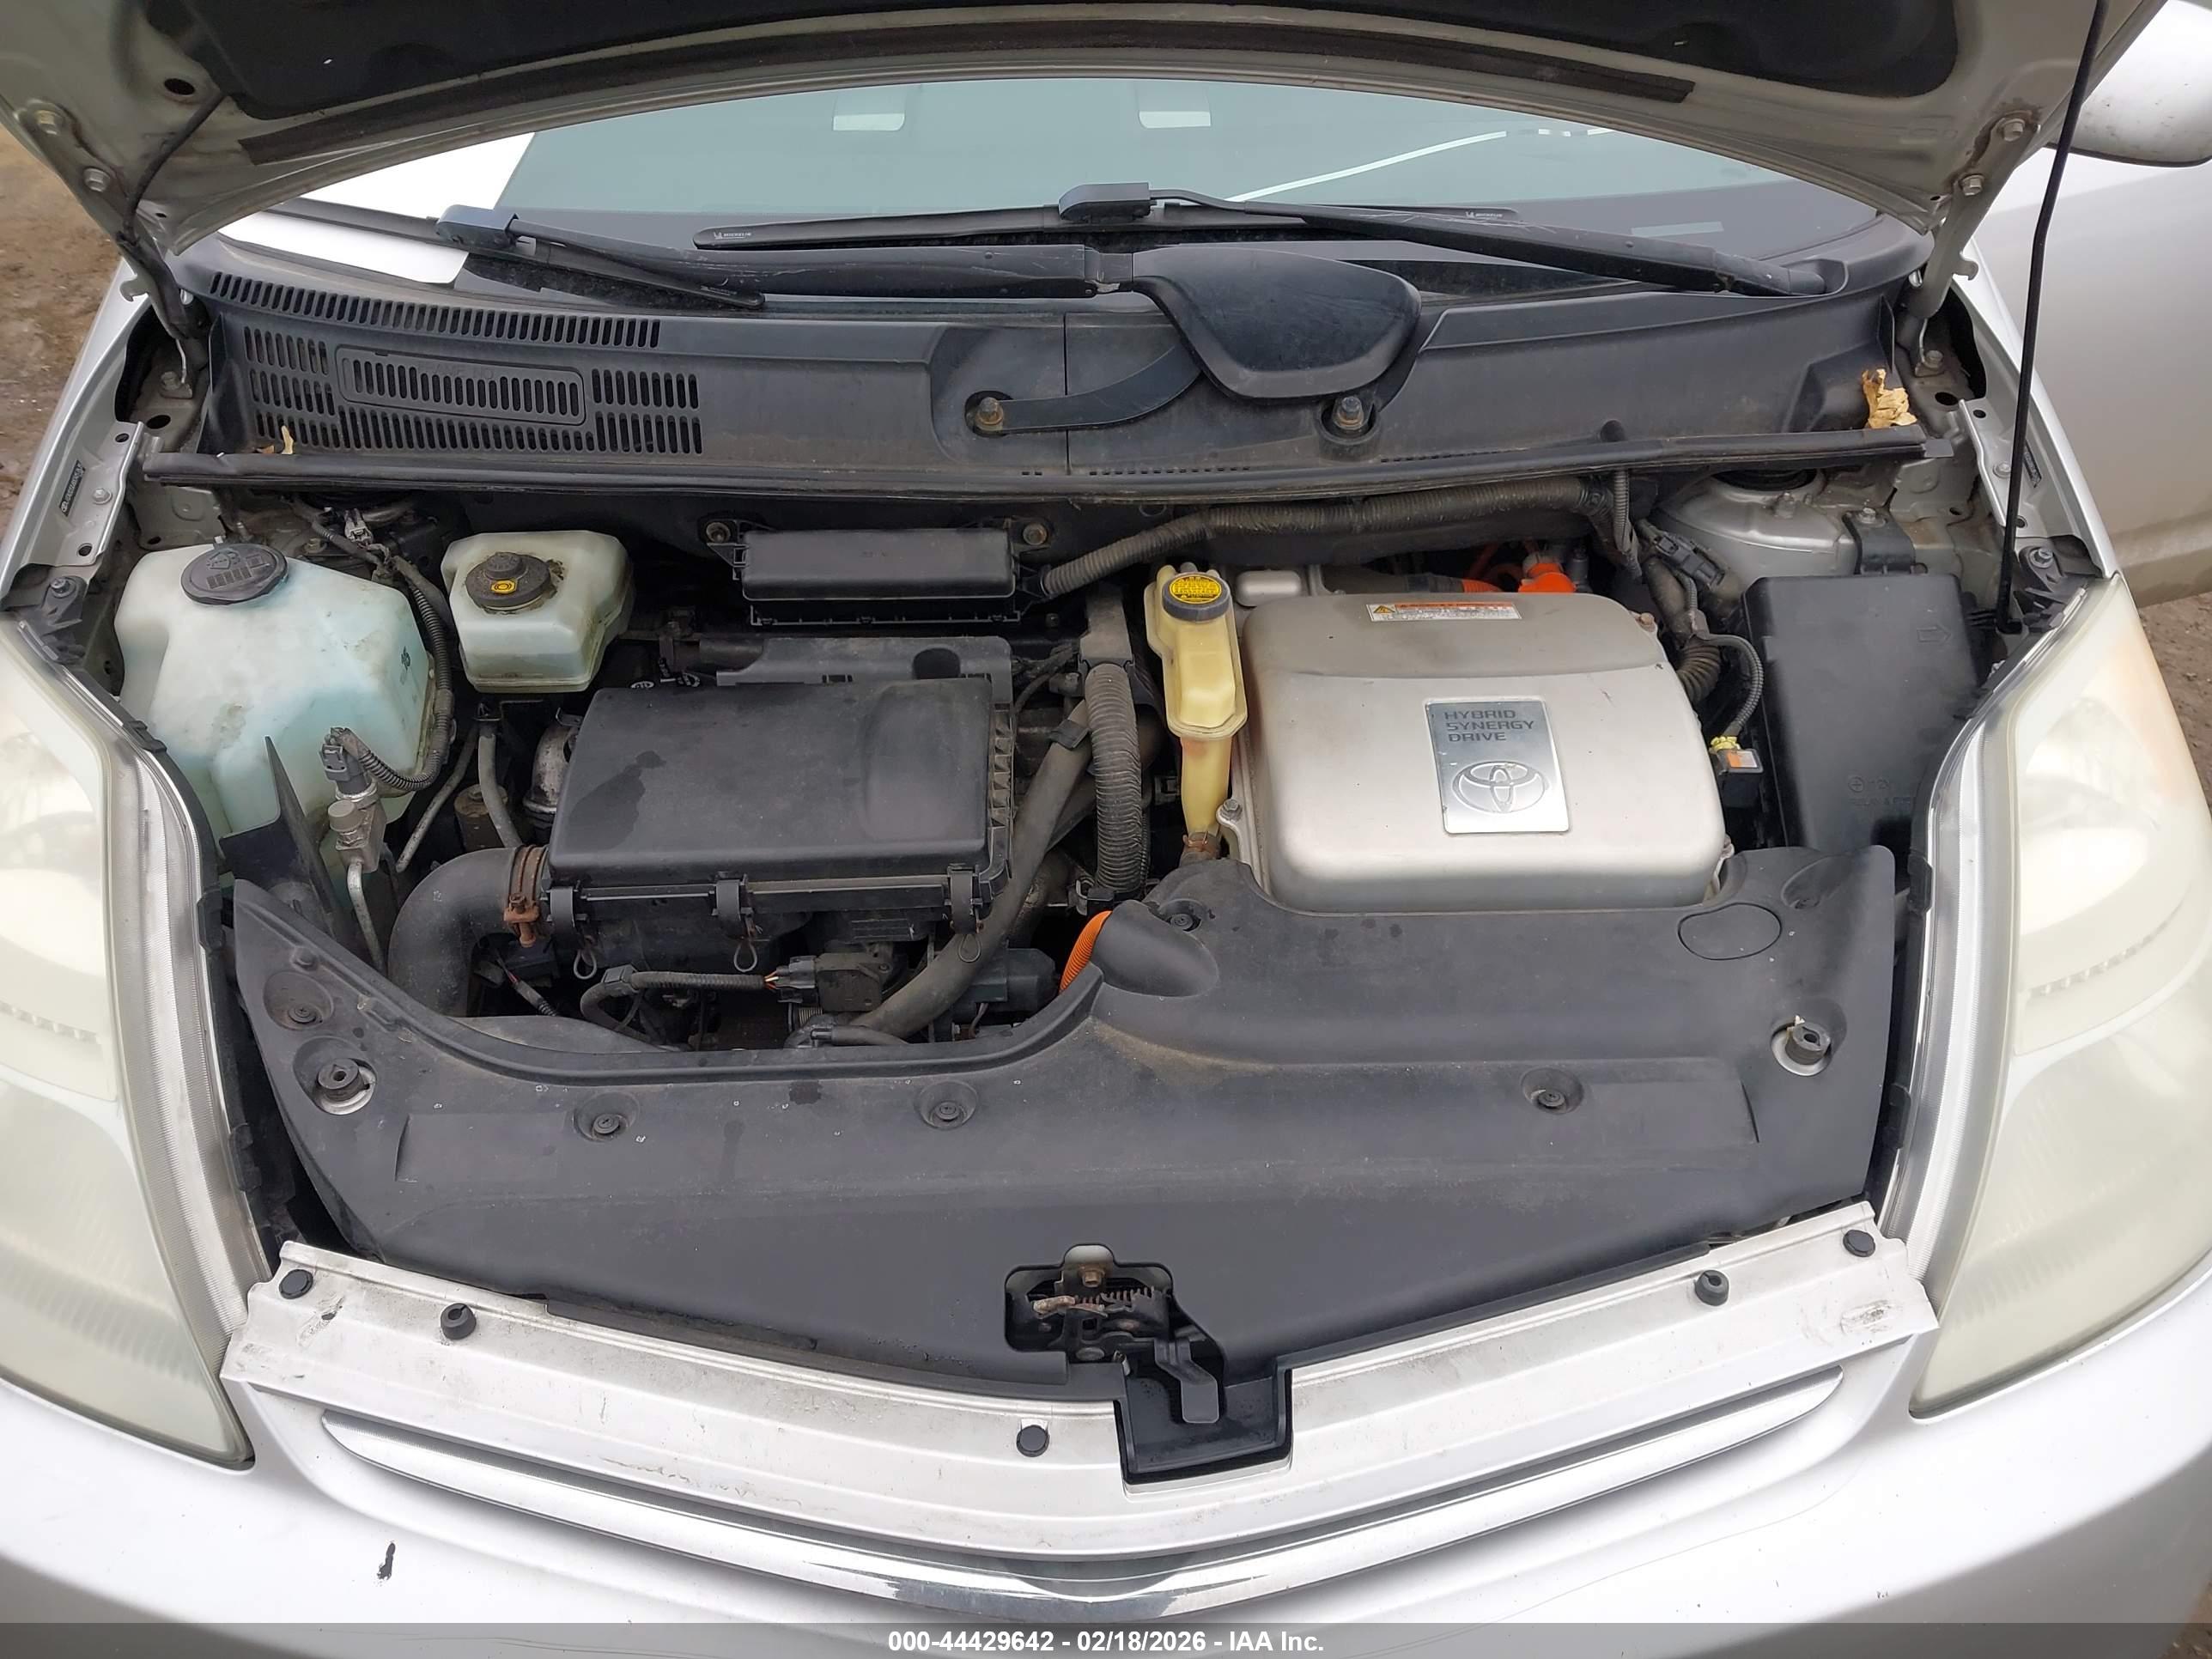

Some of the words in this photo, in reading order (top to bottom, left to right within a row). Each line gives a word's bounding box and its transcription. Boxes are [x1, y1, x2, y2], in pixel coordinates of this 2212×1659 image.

[1444, 709, 1516, 720] HYBRID
[1446, 720, 1534, 731] SYNERGY
[1449, 732, 1507, 742] DRIVE
